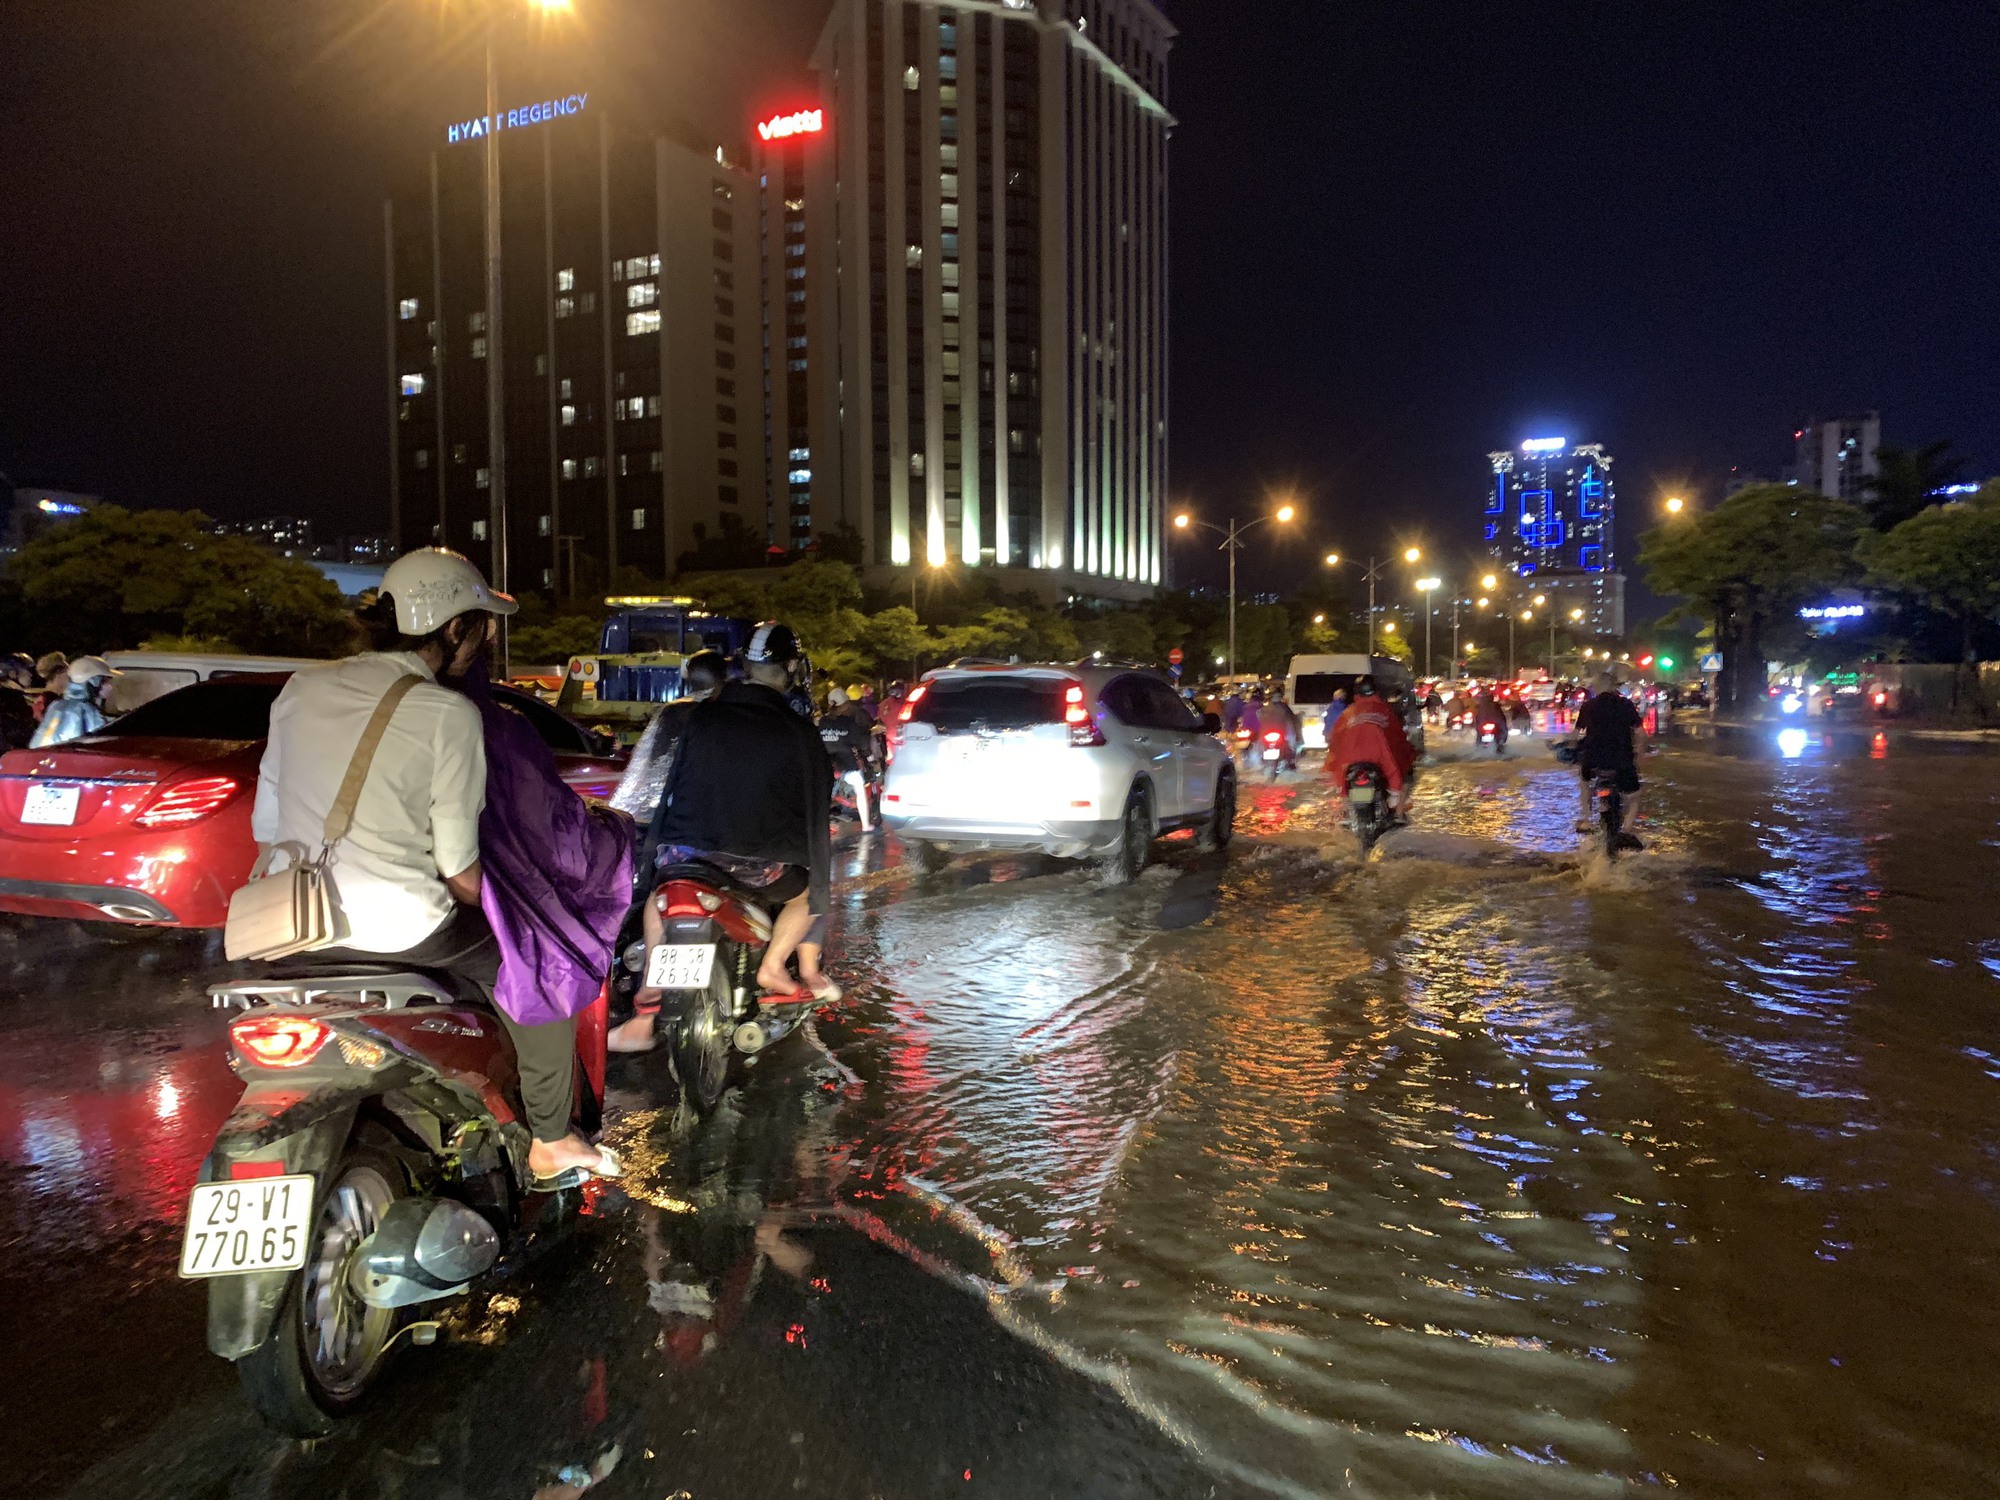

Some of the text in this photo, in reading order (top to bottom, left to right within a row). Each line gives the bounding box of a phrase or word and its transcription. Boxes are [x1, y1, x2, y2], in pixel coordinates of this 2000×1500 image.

[448, 92, 588, 143] HYATT REGENCY
[656, 967, 701, 985] 2634
[207, 1184, 290, 1225] 29-V1
[191, 1225, 298, 1269] 770.65
